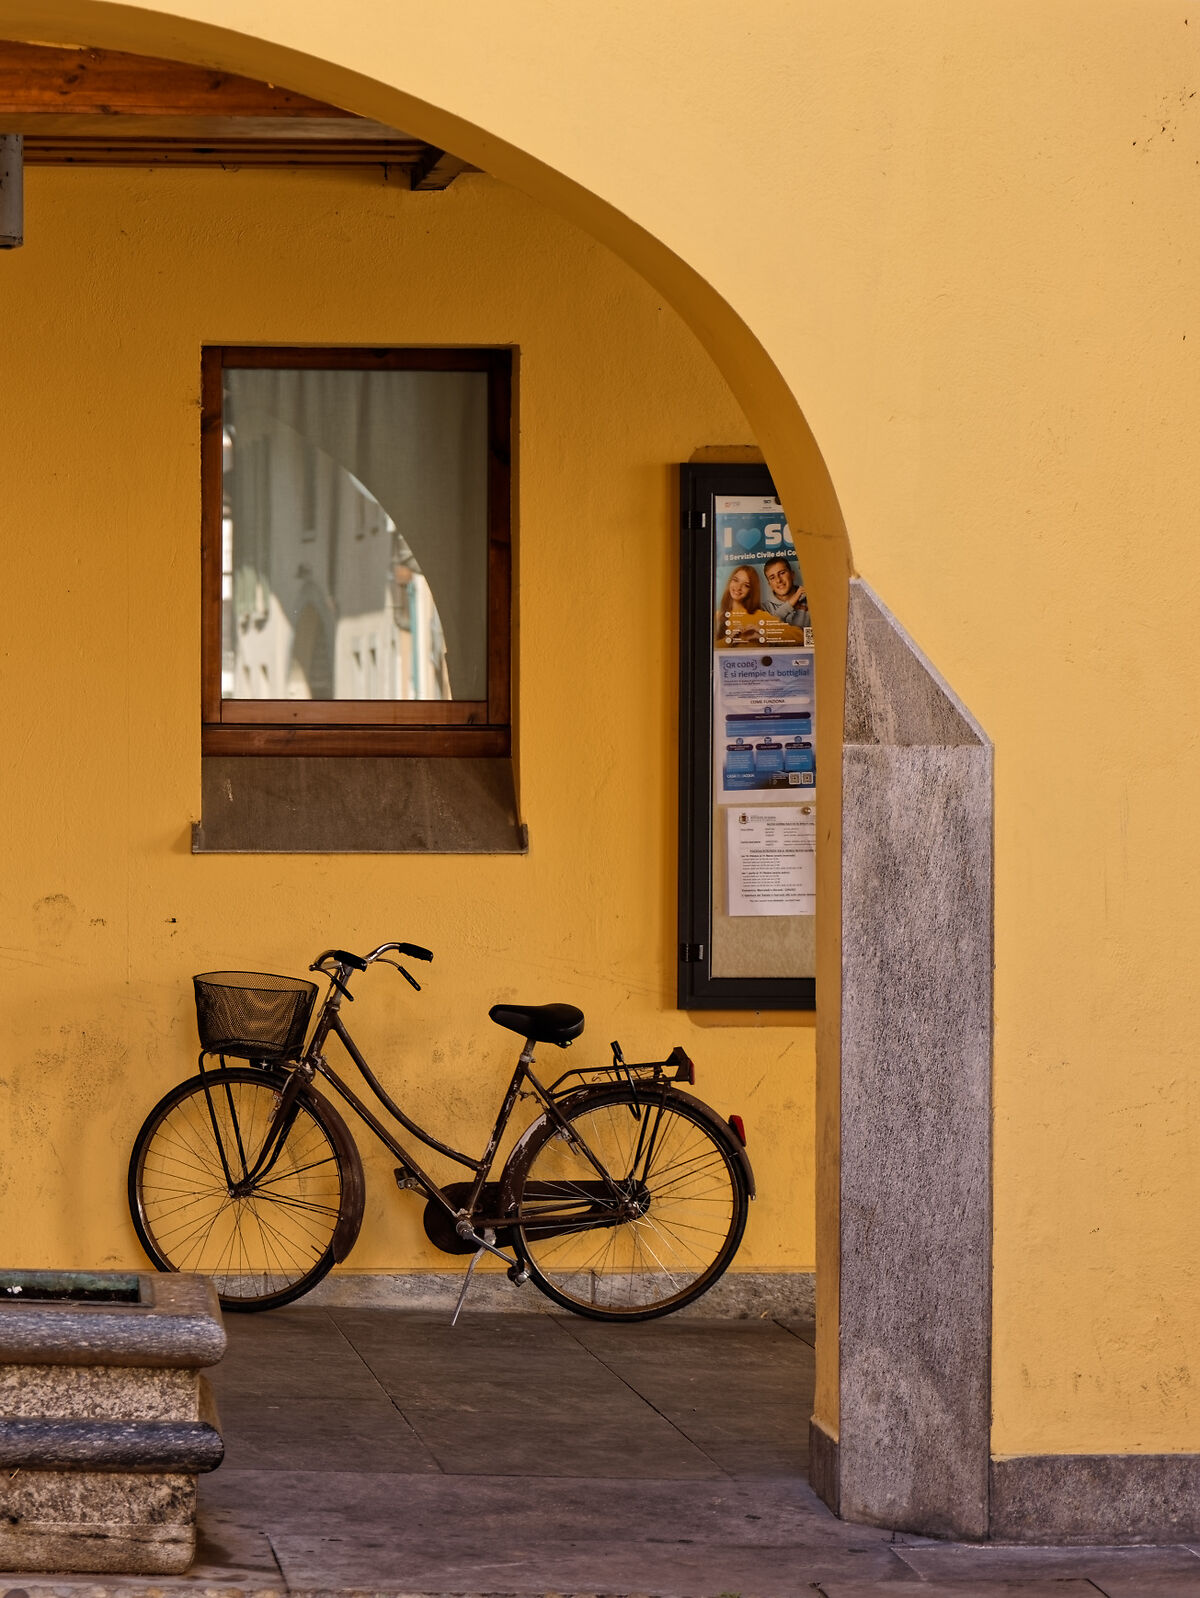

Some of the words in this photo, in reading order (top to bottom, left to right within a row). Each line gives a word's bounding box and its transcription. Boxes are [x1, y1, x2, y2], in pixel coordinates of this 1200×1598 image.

[724, 527, 732, 548] I
[730, 553, 756, 561] Servizio
[756, 551, 775, 559] Civile
